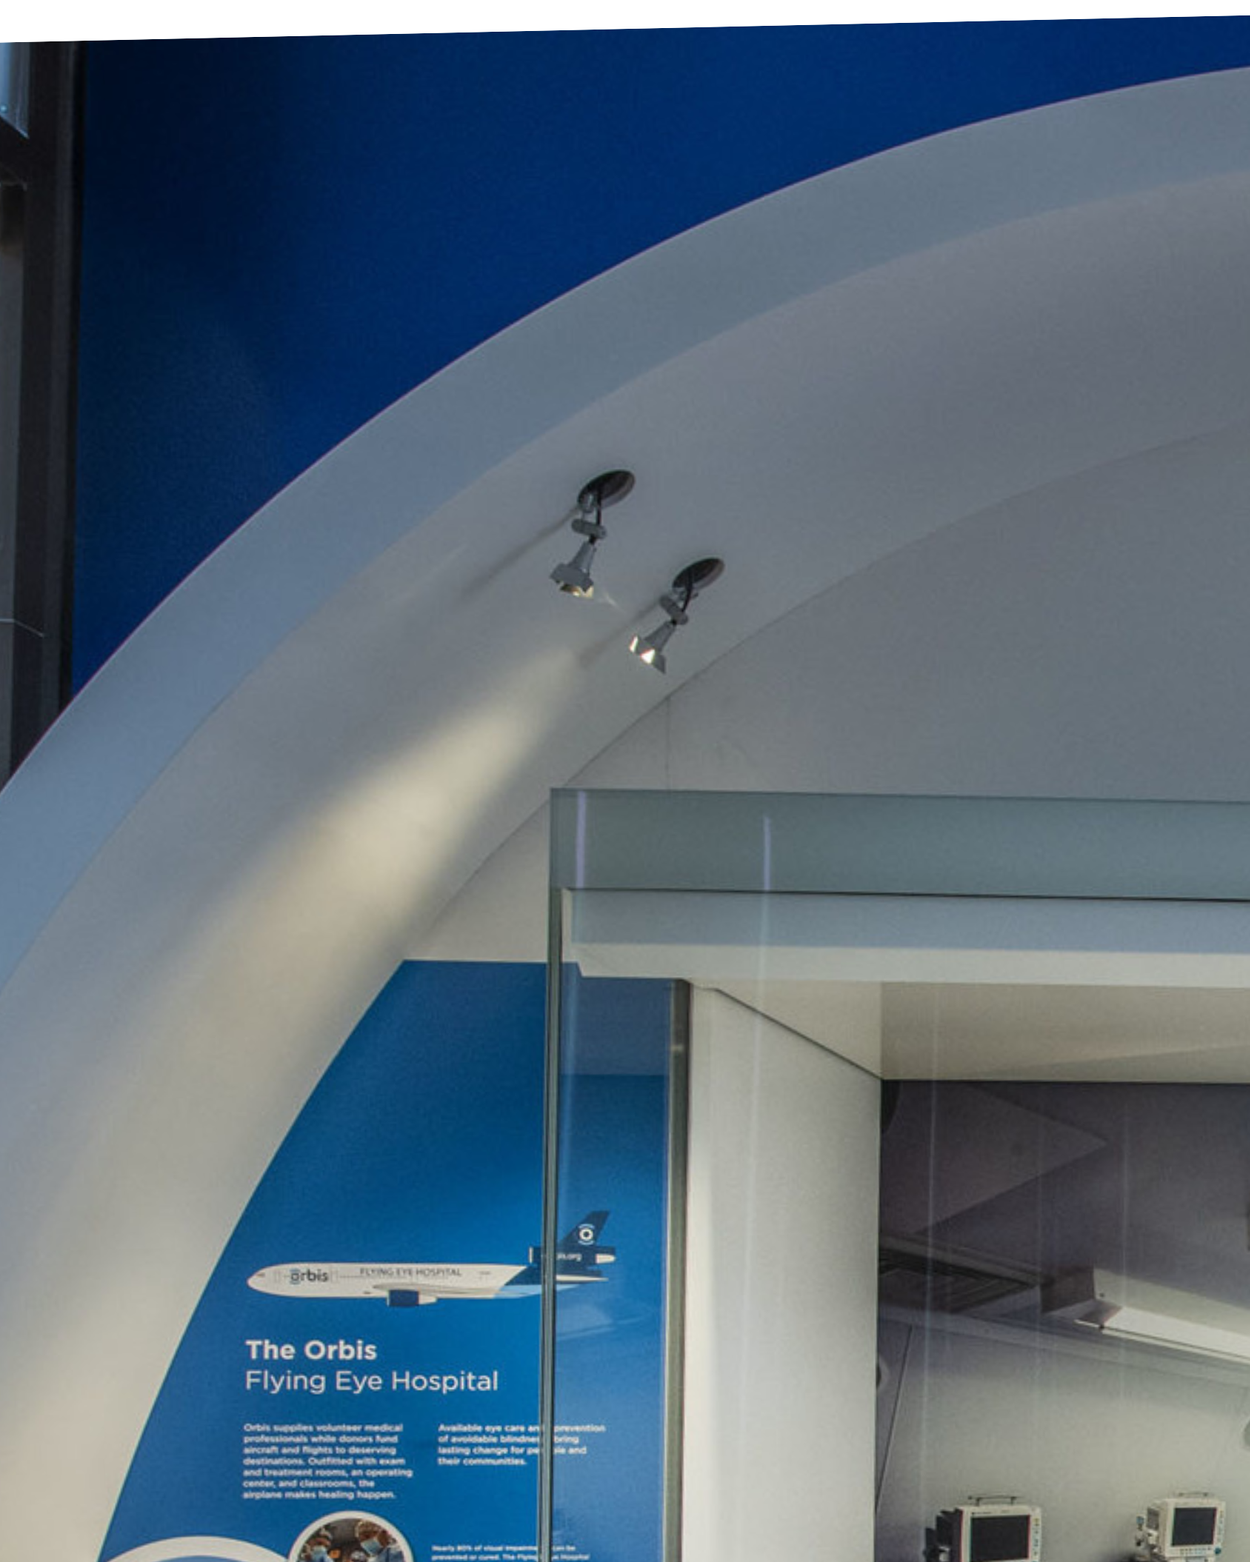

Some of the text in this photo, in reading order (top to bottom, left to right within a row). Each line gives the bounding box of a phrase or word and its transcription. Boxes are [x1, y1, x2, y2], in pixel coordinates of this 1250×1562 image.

[290, 1269, 329, 1282] orbis
[360, 1268, 461, 1276] FLYING EYE HOSPITAL
[245, 1339, 377, 1360] The Orbis
[245, 1369, 498, 1395] Flying Eye Hospital
[243, 1424, 403, 1433] Orbis supplies volunteer medical
[438, 1424, 483, 1432] Available
[485, 1426, 502, 1434] eye
[244, 1435, 398, 1445] professionals while donors fund
[438, 1435, 449, 1443] of
[451, 1435, 498, 1443] avoidable
[500, 1435, 539, 1443] blindne
[243, 1446, 396, 1456] aircraft and flights to deserving
[438, 1446, 471, 1456] lasting
[473, 1446, 508, 1456] change
[510, 1446, 525, 1454] for
[567, 1446, 587, 1454] and
[243, 1457, 304, 1465] destinations.
[308, 1457, 353, 1465] Outfitted
[356, 1457, 377, 1465] with
[437, 1457, 526, 1465] their communities.
[315, 1470, 348, 1478] rooms,
[365, 1469, 413, 1478] operating
[243, 1480, 276, 1489] center,
[299, 1480, 356, 1489] classrooms,
[242, 1491, 394, 1500] airplane makes healing happen.
